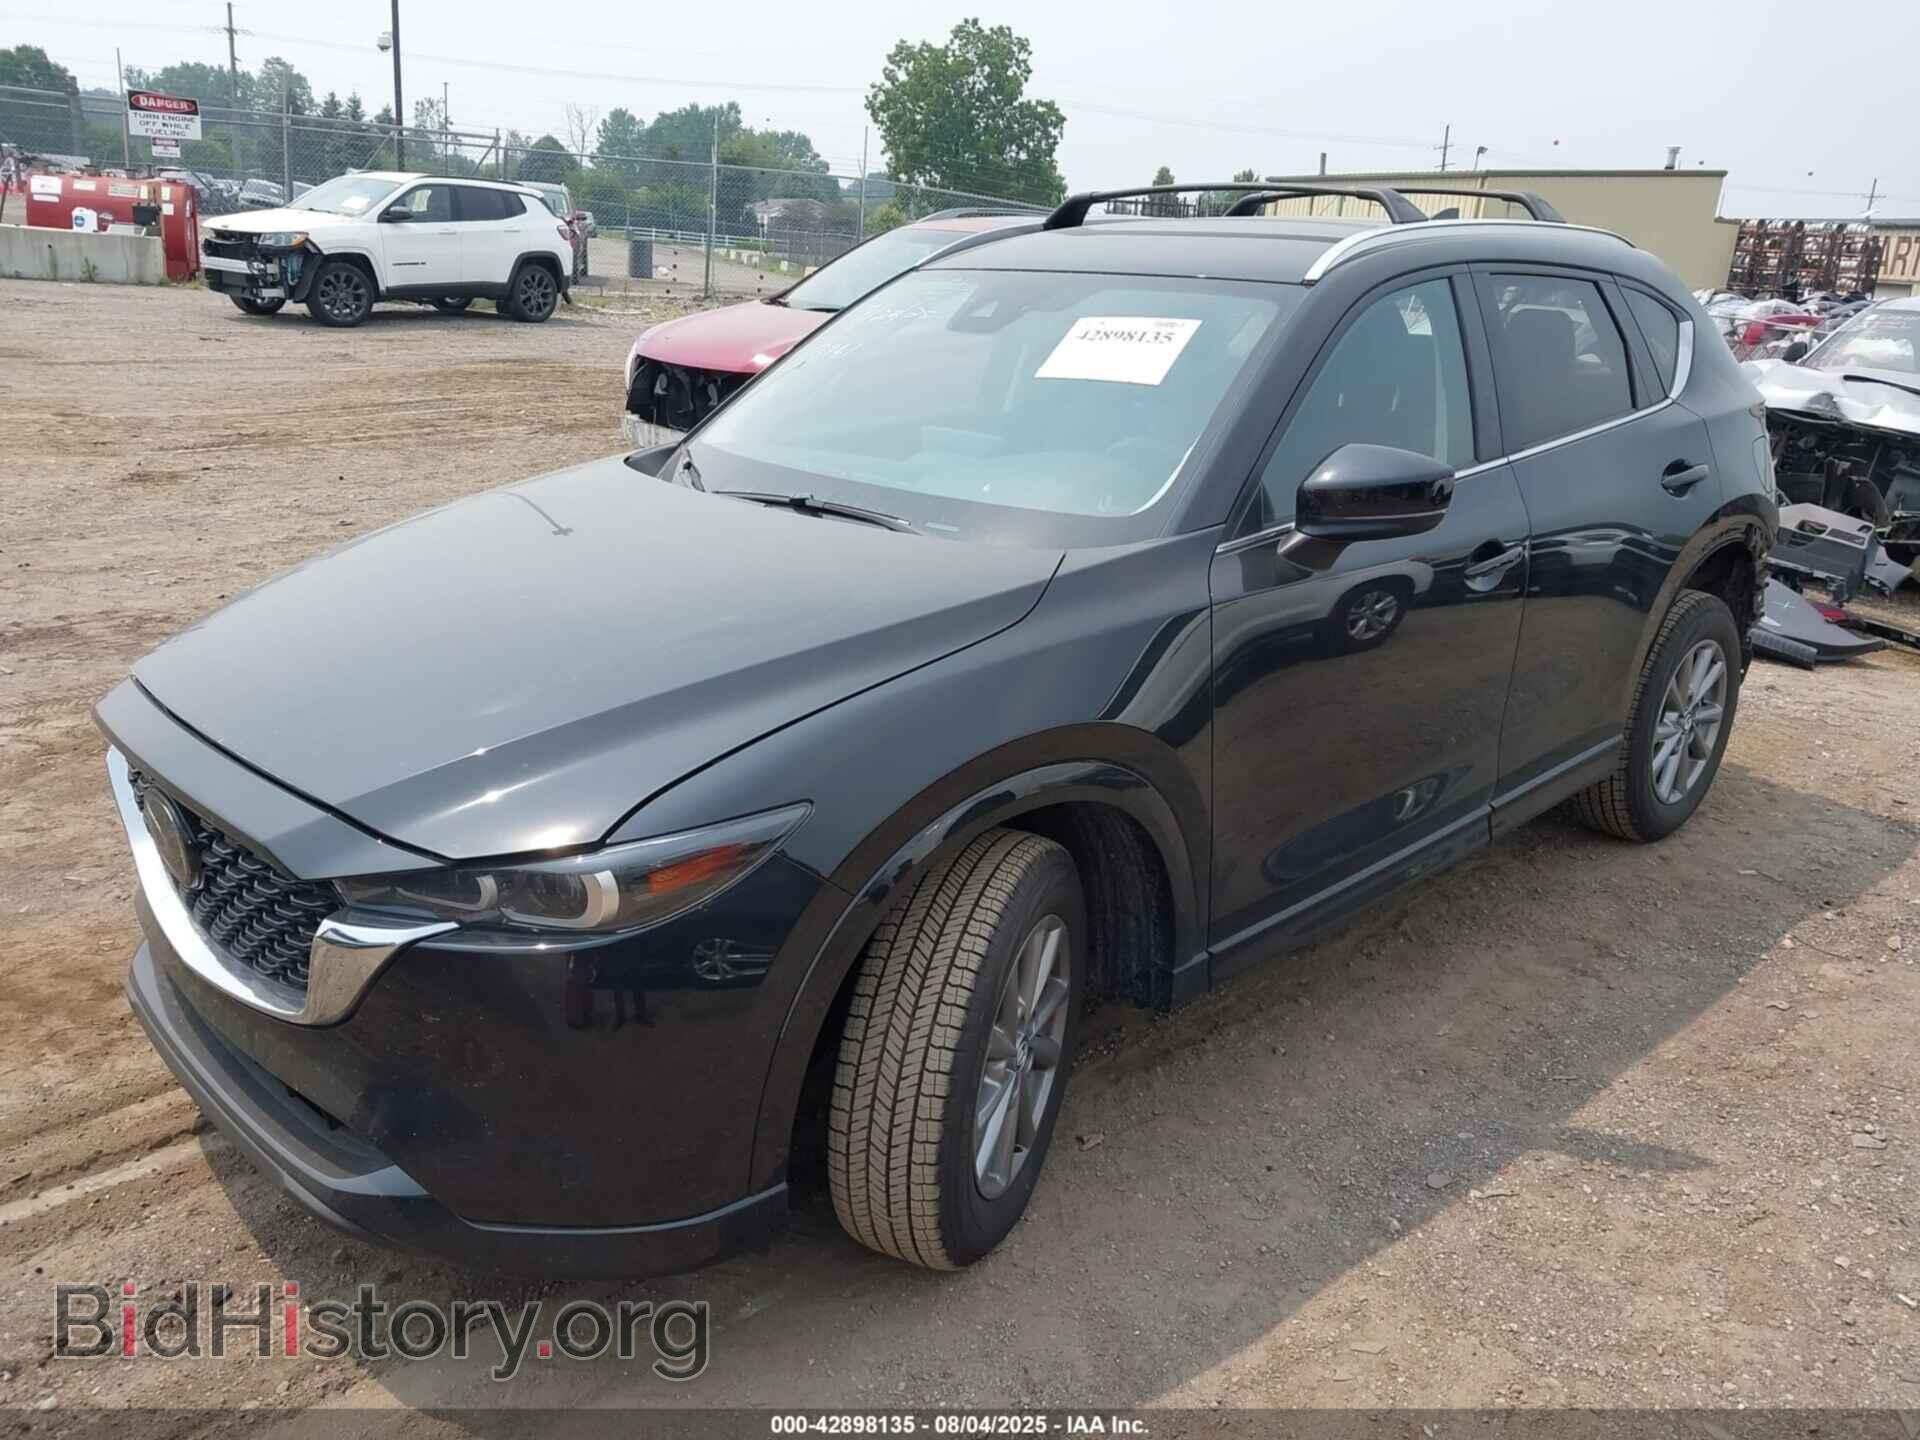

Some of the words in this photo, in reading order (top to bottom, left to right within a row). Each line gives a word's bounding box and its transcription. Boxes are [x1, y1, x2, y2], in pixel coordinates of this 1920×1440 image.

[139, 95, 188, 110] DANGER
[133, 112, 160, 120] TURN
[162, 122, 190, 130] WHILE
[145, 128, 187, 137] FUELING
[1075, 328, 1177, 345] 42898135
